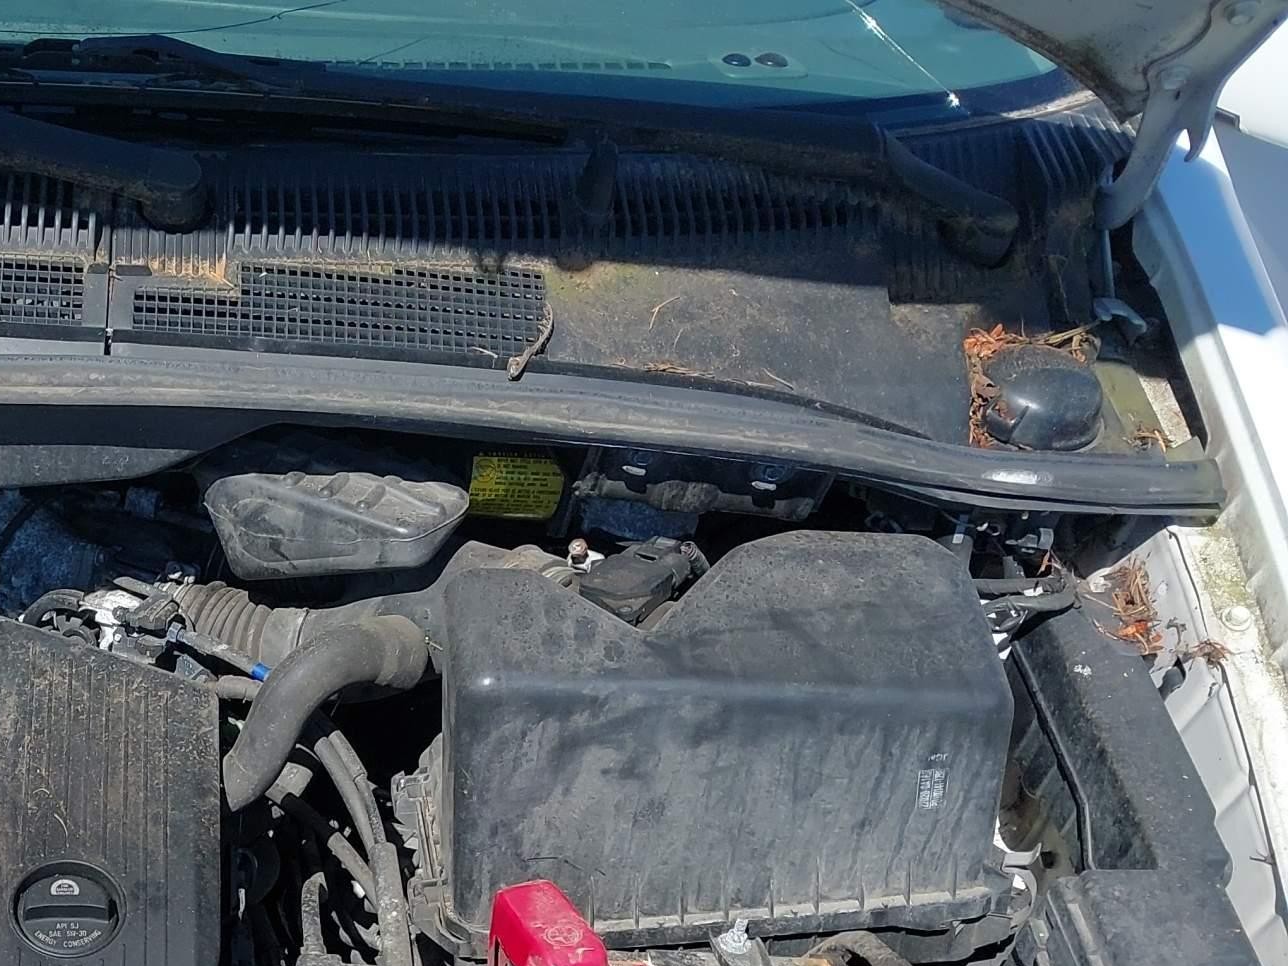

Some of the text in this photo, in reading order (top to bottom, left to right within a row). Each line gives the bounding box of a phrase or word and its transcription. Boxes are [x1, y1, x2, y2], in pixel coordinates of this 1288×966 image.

[34, 929, 102, 948] ENERGY CONSERVING
[48, 930, 62, 938] SAE
